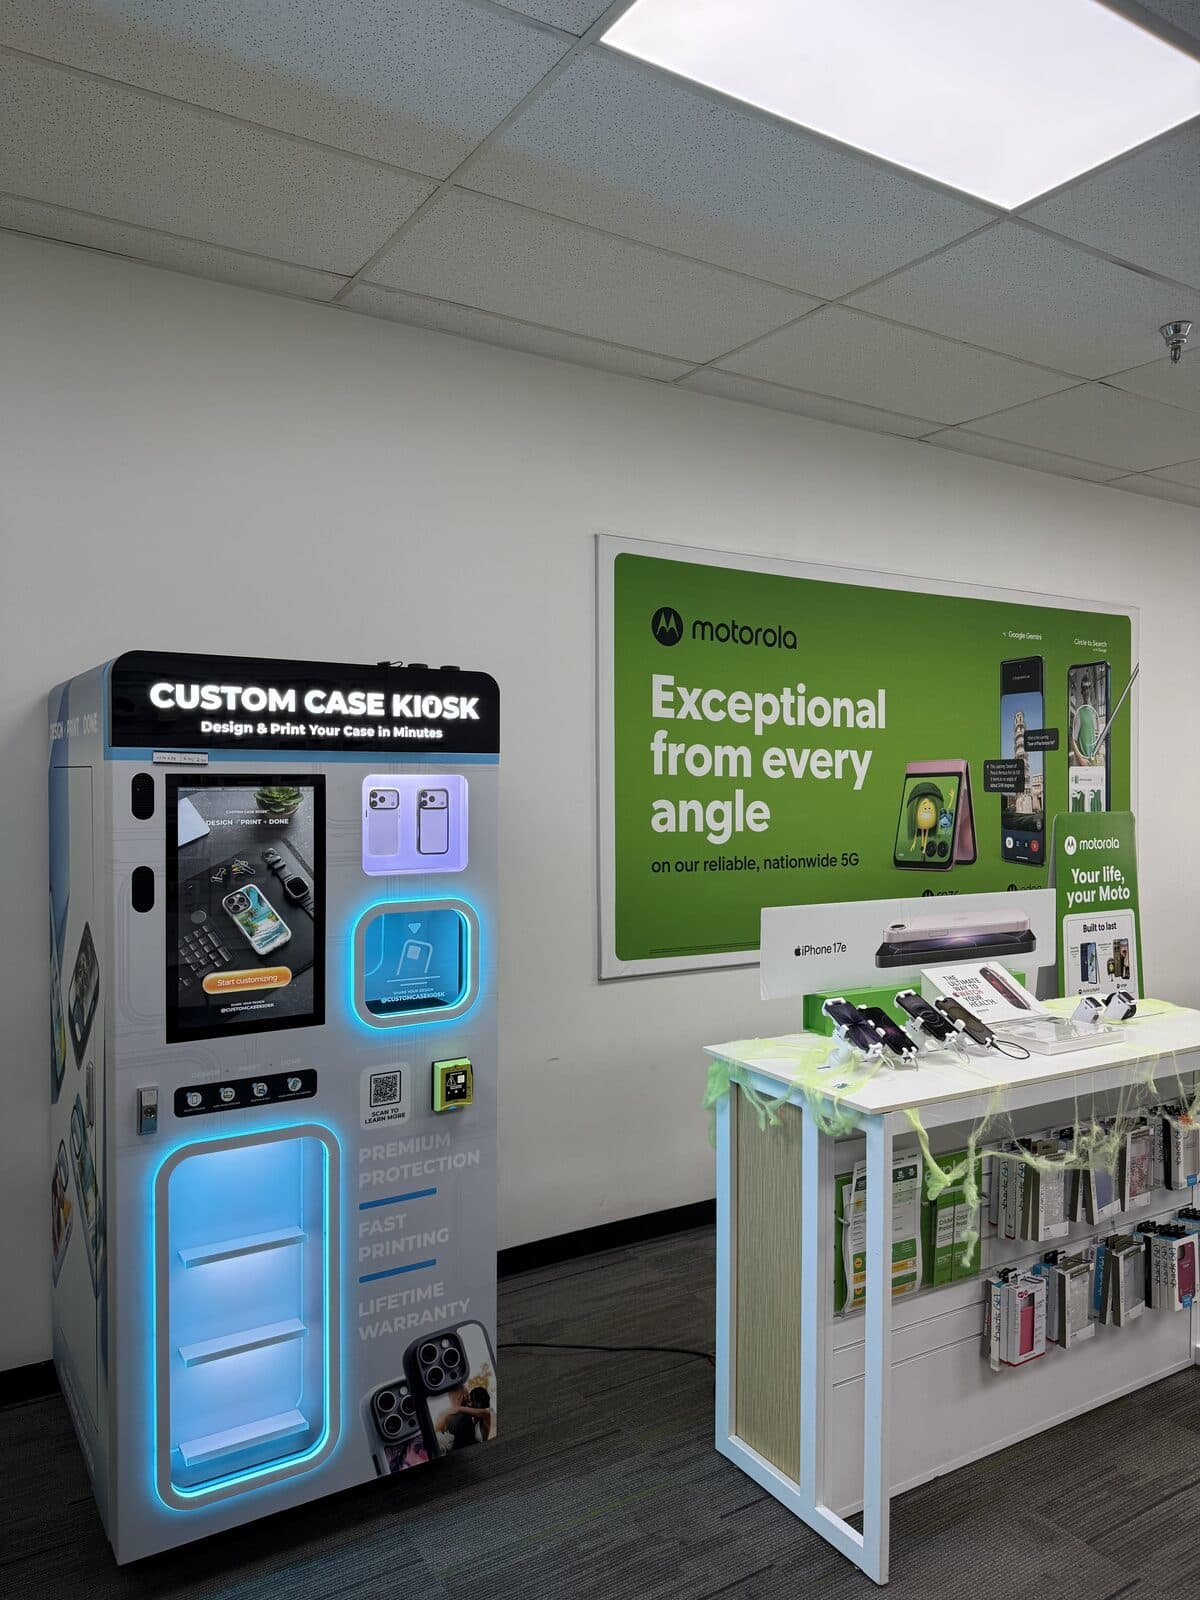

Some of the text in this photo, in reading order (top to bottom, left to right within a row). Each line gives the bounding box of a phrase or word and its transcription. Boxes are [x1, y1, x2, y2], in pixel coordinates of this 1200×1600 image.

[692, 619, 798, 650] motorola
[149, 682, 480, 720] CUSTOM CASE KIOSK
[652, 673, 886, 736] Exceptional
[201, 720, 443, 740] Design & Print Your Case in Minutes
[650, 729, 873, 790] from every
[206, 819, 233, 827] DESIGN
[268, 818, 289, 826] DONE
[651, 789, 771, 845] angle
[1079, 837, 1120, 850] motorola
[651, 852, 860, 873] on our reliable, nationwide 5G
[1071, 865, 1125, 884] Your life,
[1066, 886, 1131, 909] your Moto
[1082, 922, 1117, 933] Built to last
[801, 942, 847, 956] iPhone 17e
[217, 975, 278, 987] Start customizing
[947, 977, 982, 987] ULTIMATE
[963, 995, 986, 1003] YOUR
[364, 1112, 406, 1125] LEARN MORE
[371, 1107, 399, 1118] SCAN TO
[359, 1131, 451, 1163] PREMIUM
[359, 1149, 481, 1188] PROTECTION
[358, 1213, 407, 1240] FAST
[358, 1227, 450, 1262] PRINTING
[358, 1281, 444, 1318] LIFETIME
[358, 1298, 471, 1341] WARRANTY
